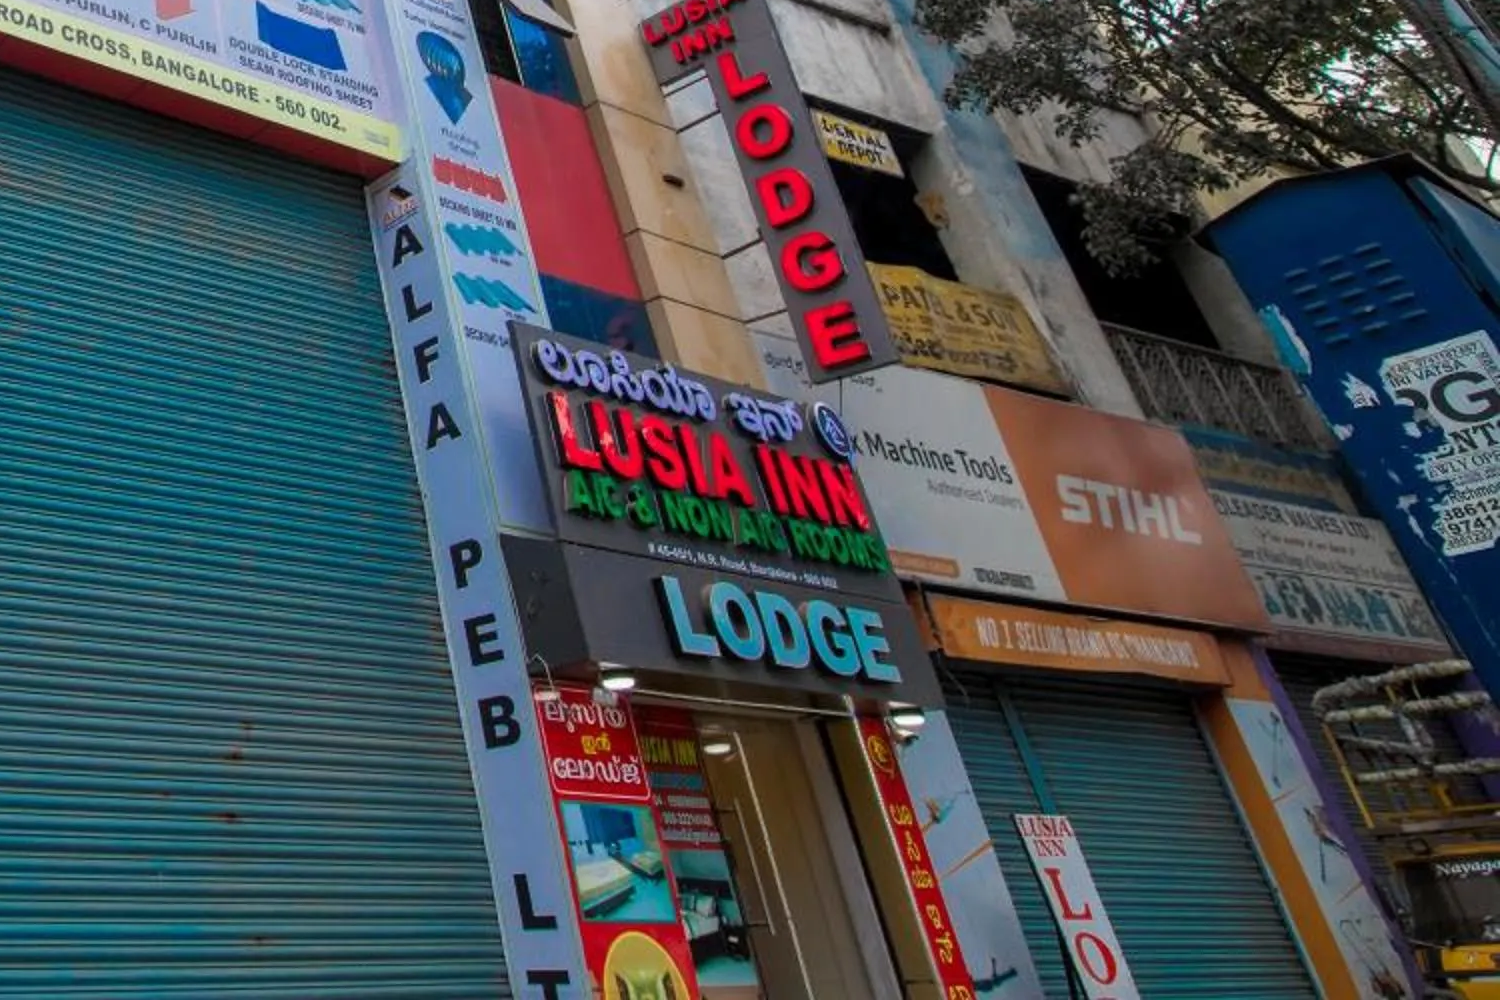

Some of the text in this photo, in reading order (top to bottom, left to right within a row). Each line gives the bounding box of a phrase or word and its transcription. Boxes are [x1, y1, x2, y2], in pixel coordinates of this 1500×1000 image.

[139, 17, 151, 31] C
[155, 23, 217, 55] PURLIN
[229, 36, 379, 99] DOUBLE LOCK STANDING
[671, 16, 735, 63] INN
[61, 25, 138, 65] CROSS,
[141, 50, 260, 104] BANGALORE
[275, 95, 306, 119] 560
[238, 55, 373, 112] SEAM ROOFING SHEET
[716, 50, 872, 370] LODGE
[392, 223, 462, 450] ALFA
[546, 390, 870, 531] LUSIA INN
[862, 430, 957, 475] Machine
[954, 449, 1013, 485] Tools
[567, 468, 890, 573] A/C & NON A/C ROOMS
[1055, 473, 1202, 546] STIHL
[449, 538, 521, 749] PEB
[654, 575, 900, 684] LODGE
[1001, 619, 1014, 649] 1
[1019, 817, 1073, 838] LUSIA
[1033, 839, 1067, 857] INN
